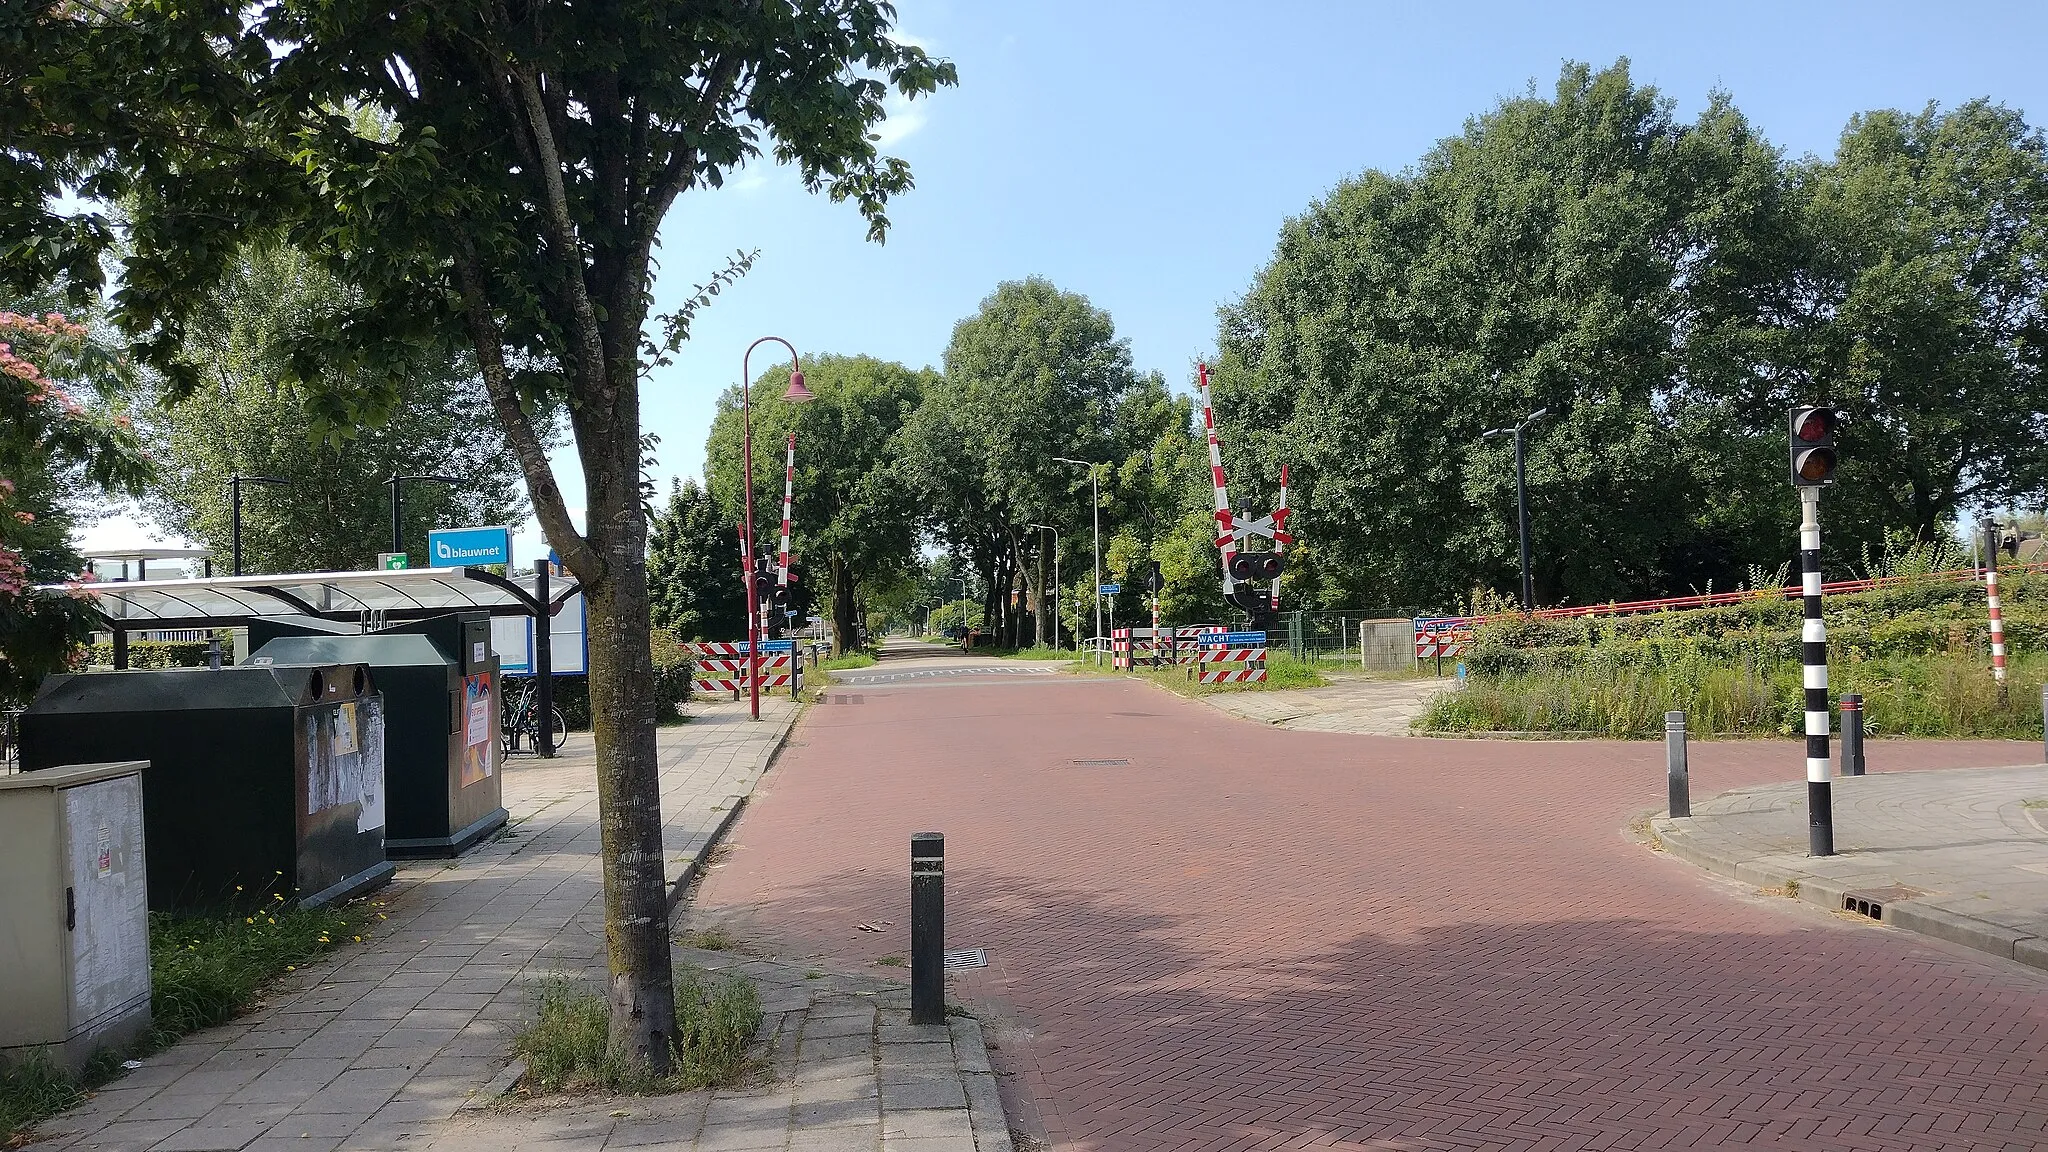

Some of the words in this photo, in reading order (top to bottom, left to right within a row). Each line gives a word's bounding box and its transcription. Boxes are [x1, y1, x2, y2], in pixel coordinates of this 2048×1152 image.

[452, 546, 499, 558] blauwnet
[1199, 634, 1230, 643] WACHT
[739, 642, 766, 651] WAHT
